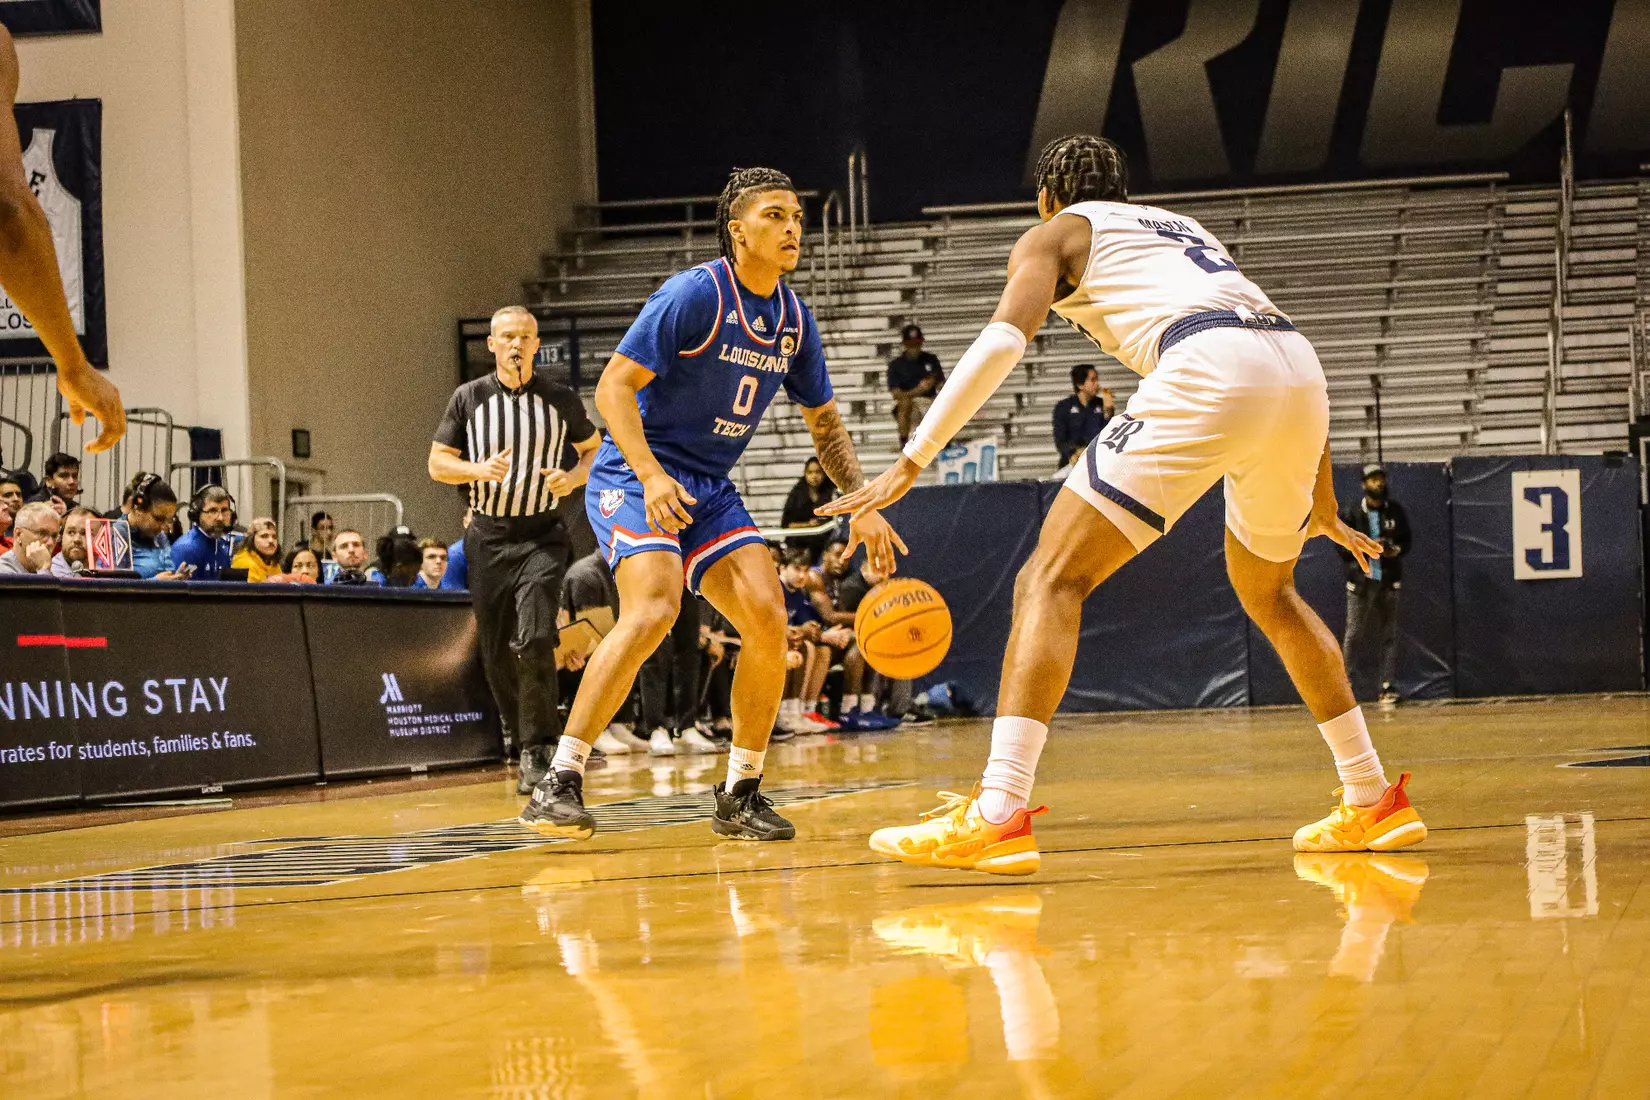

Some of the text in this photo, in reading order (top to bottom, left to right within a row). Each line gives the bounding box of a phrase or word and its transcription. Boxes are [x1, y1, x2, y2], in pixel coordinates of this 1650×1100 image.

[1021, 0, 1650, 186] RIC
[1138, 218, 1194, 234] MASON
[718, 343, 789, 374] LOUISIANA
[732, 374, 759, 417] 0
[712, 417, 751, 438] TECH
[1523, 486, 1570, 571] 3
[143, 676, 229, 715] STAY
[386, 703, 423, 714] MARRIOTT
[388, 715, 423, 726] HOUSTON
[424, 713, 453, 724] MEDICAL
[389, 725, 451, 737] MUSEUM DISTRICT
[0, 730, 257, 764] rates for students, families & fans.
